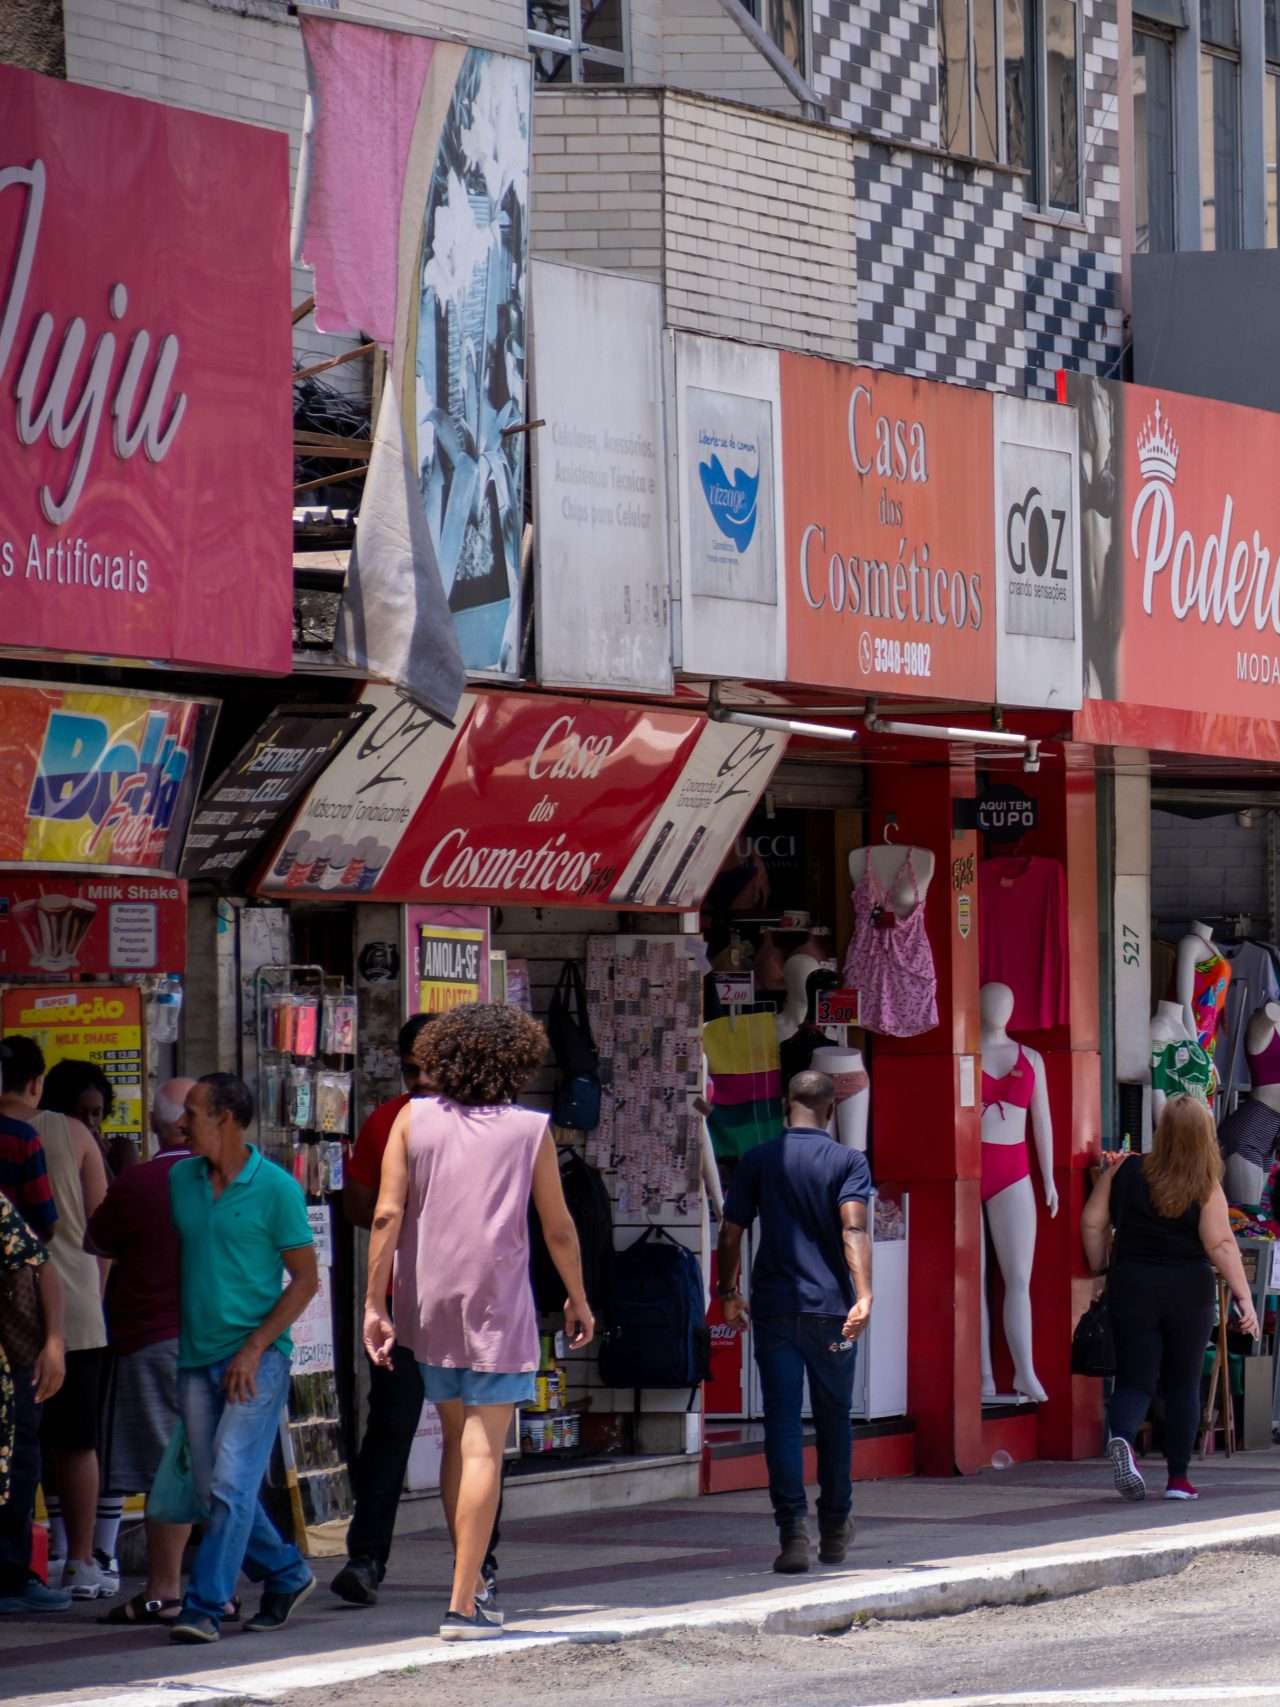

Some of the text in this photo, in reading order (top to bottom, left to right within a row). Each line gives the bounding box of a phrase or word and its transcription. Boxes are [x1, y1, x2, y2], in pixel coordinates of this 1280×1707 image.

[847, 384, 928, 483] Casa
[878, 488, 904, 529] dos
[25, 536, 149, 594] Artificiais
[799, 523, 984, 632] Cosméticos
[1008, 580, 1068, 605] criando sensações
[873, 637, 932, 678] 3348-9802
[528, 714, 613, 781] Casa
[527, 795, 558, 824] dos
[978, 800, 1032, 811] AQUI TEM
[979, 811, 1034, 827] LUPO
[420, 826, 602, 893] Cosmeticos
[87, 884, 180, 900] Milk Shake
[423, 941, 479, 980] AMOLA-SE
[1122, 924, 1141, 967] 527
